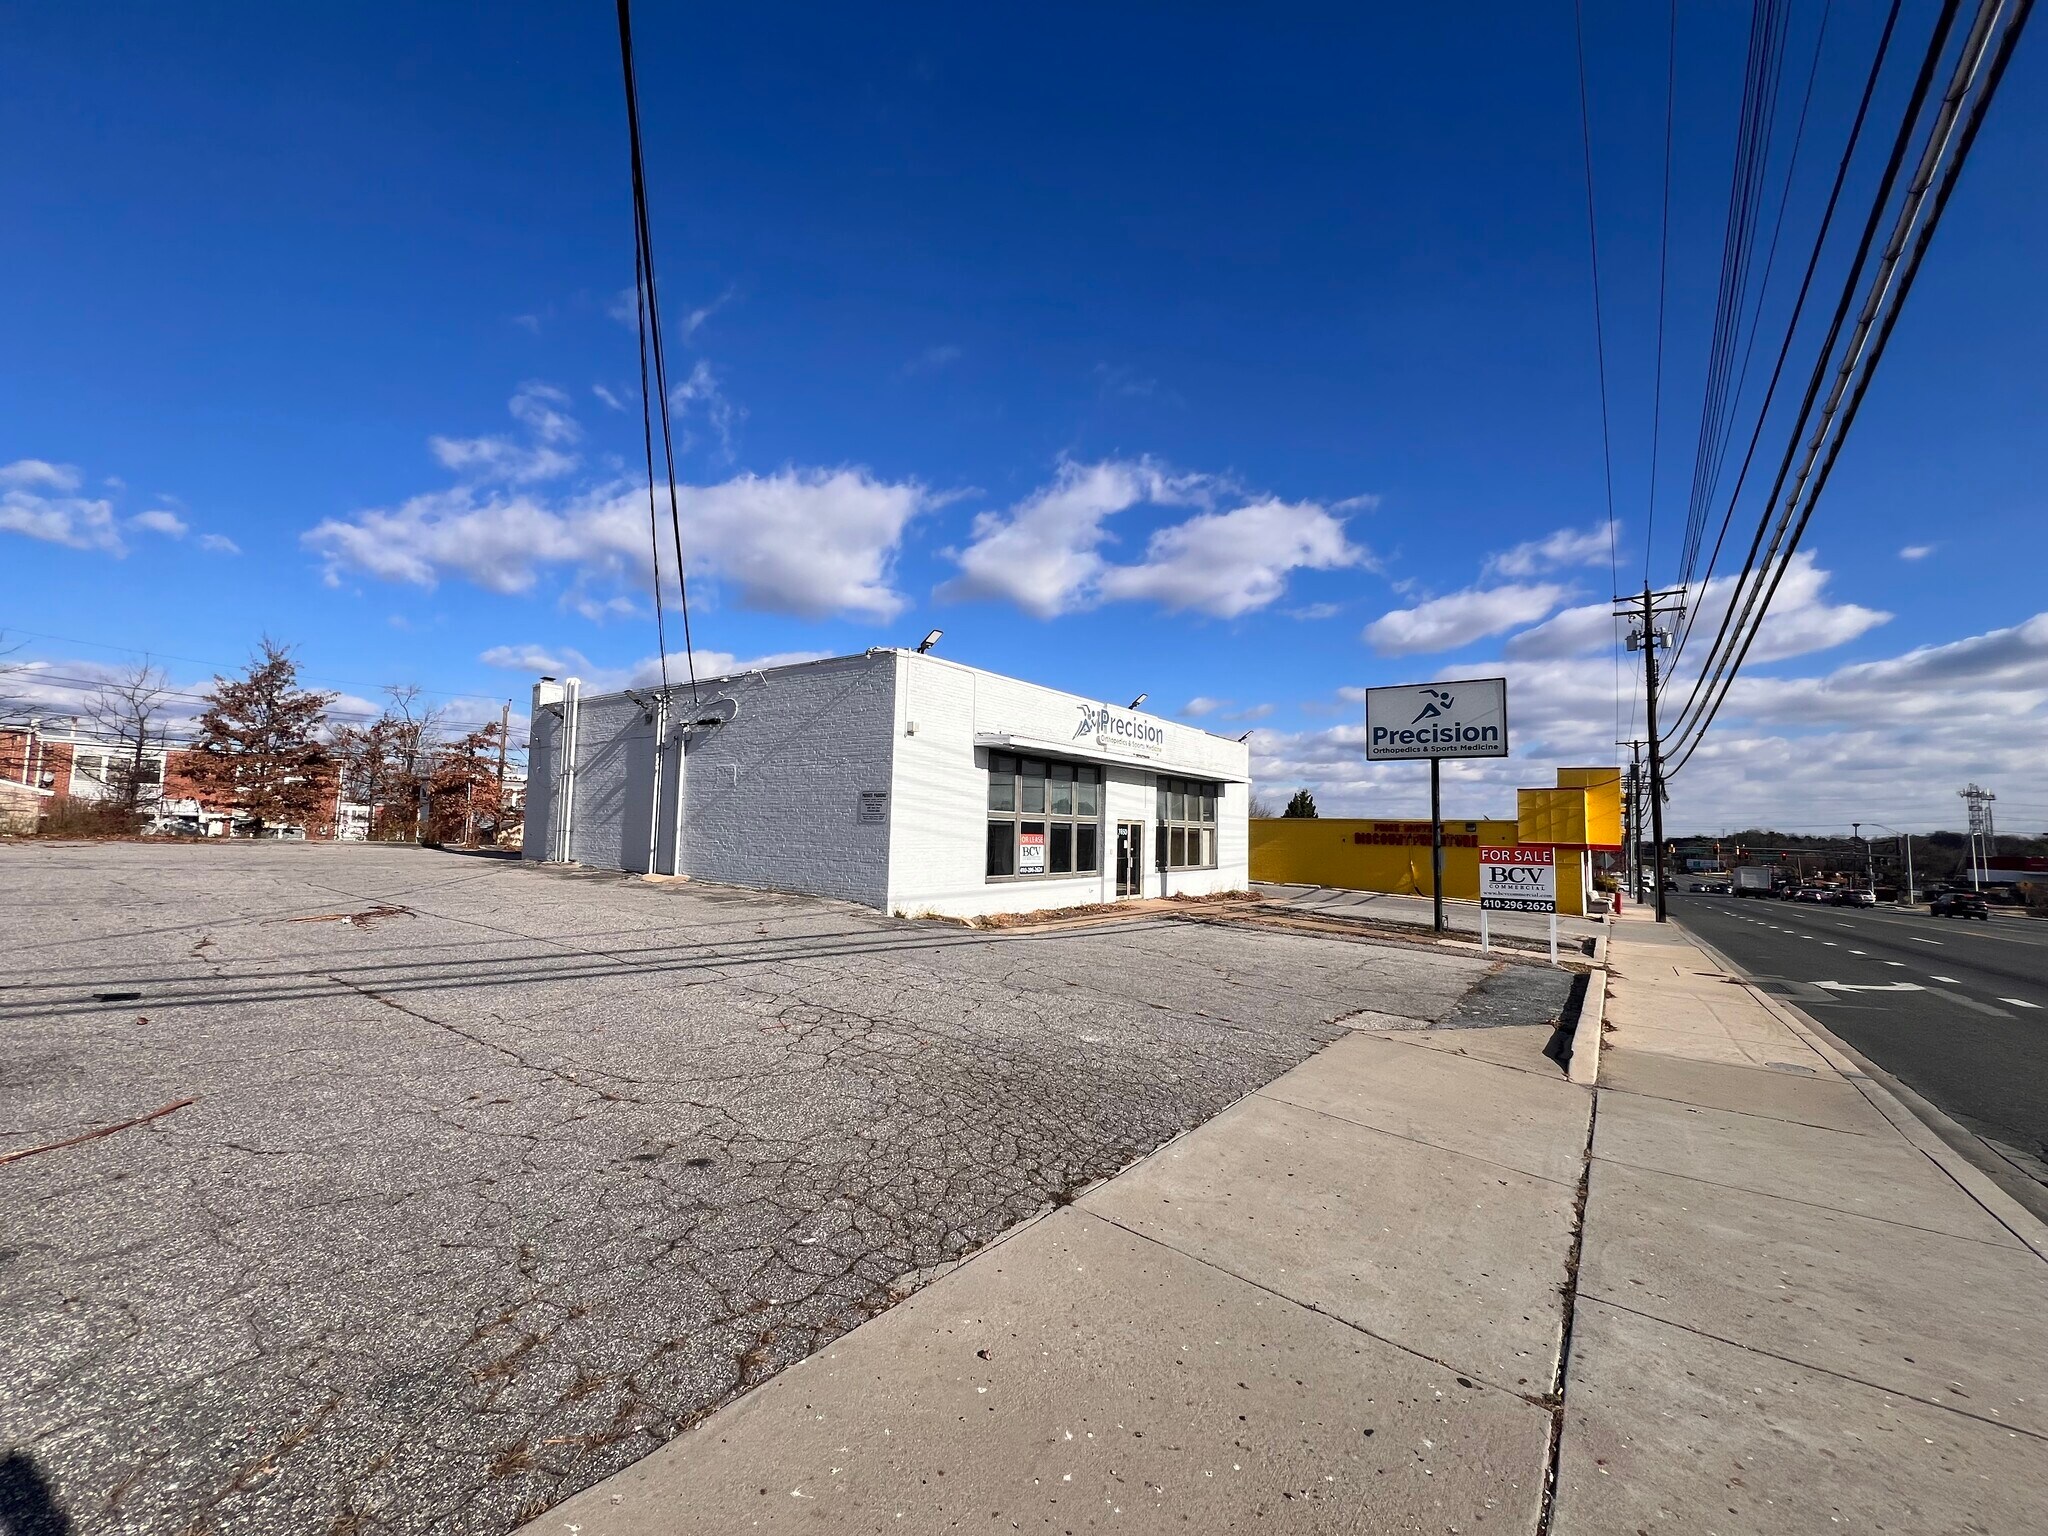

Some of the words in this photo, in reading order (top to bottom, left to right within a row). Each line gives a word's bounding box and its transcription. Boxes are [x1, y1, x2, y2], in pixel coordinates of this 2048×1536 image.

[1101, 709, 1163, 744] Precision
[1373, 722, 1498, 745] Precision
[1372, 746, 1421, 754] Orthopedics
[1029, 836, 1043, 844] LEASE
[1022, 846, 1041, 857] BCV
[1481, 849, 1510, 861] FOR
[1514, 850, 1551, 862] SALE
[1489, 866, 1545, 883] BCV
[1482, 899, 1554, 911] 410-296-2626
